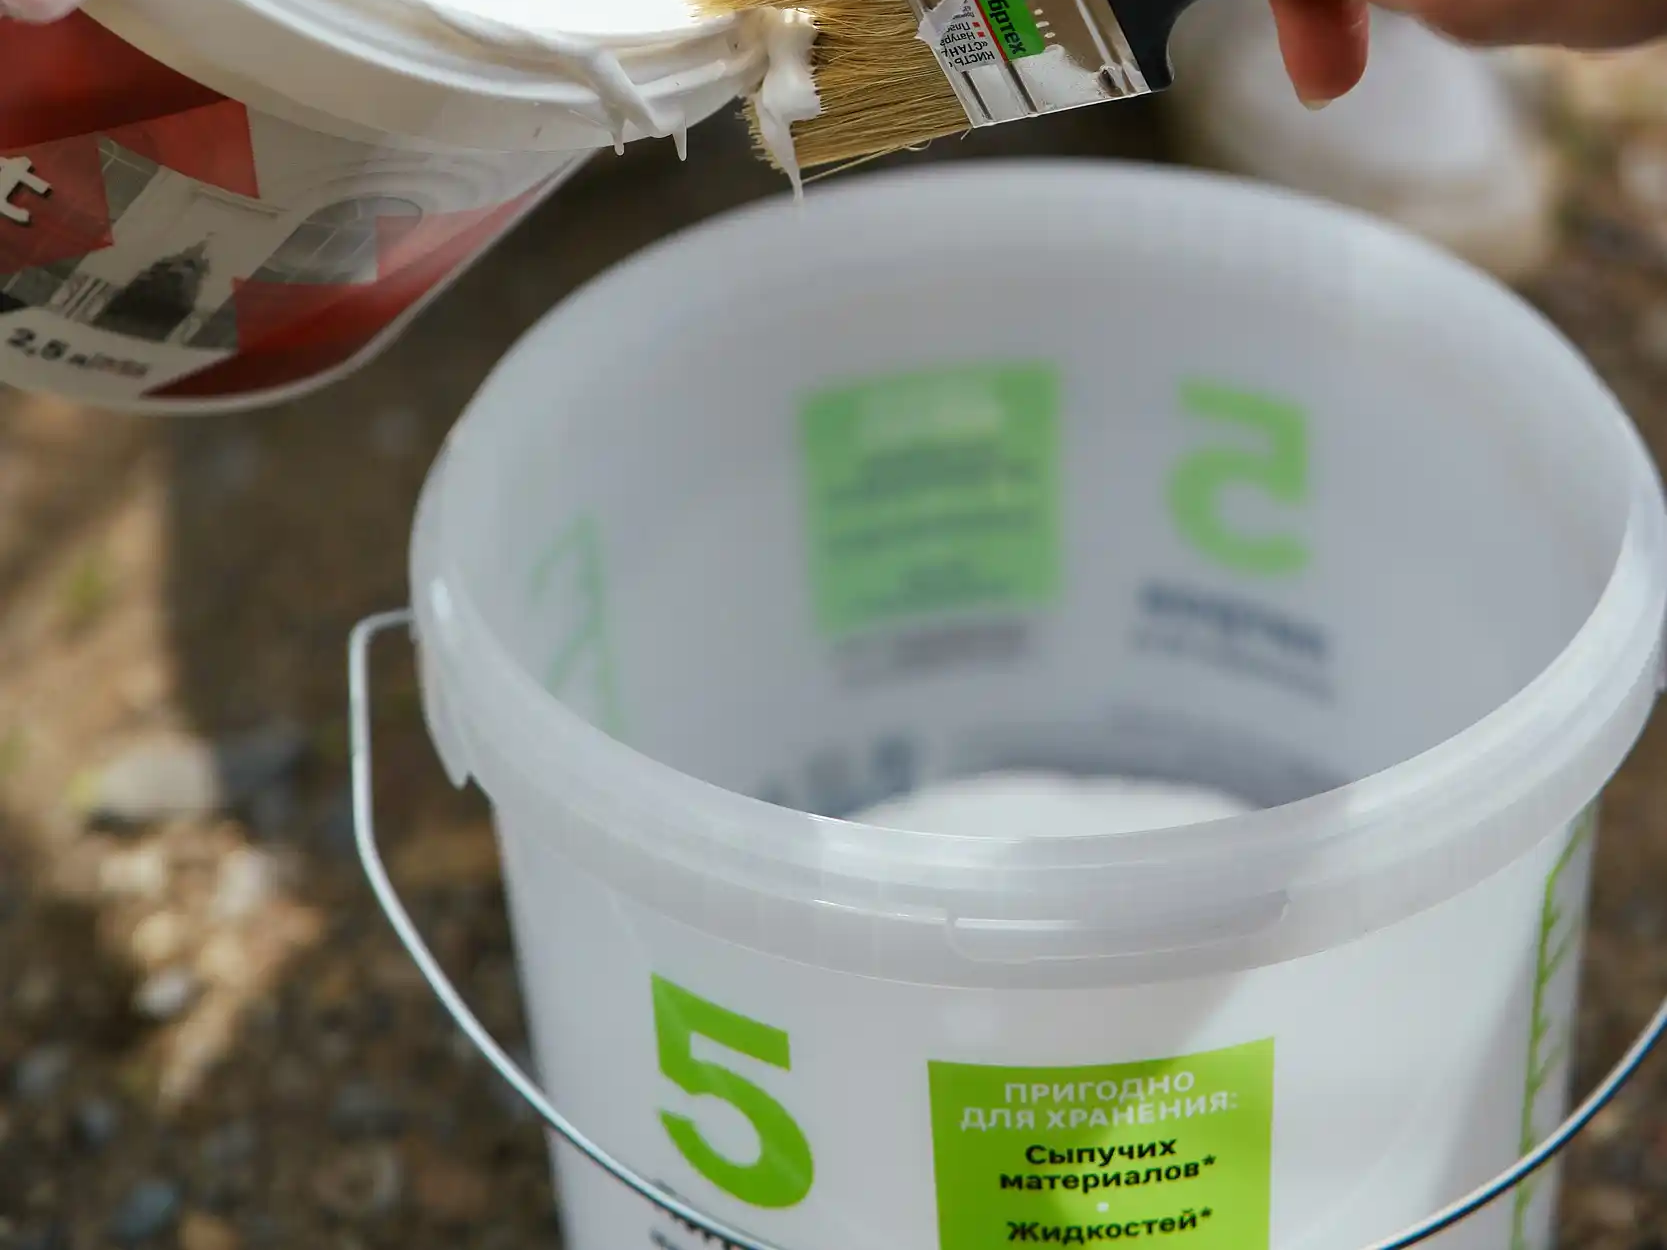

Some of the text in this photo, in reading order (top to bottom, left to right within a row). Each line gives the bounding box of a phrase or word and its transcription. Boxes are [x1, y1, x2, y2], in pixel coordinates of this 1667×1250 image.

[955, 50, 996, 67] КИСТЬ
[650, 970, 815, 1211] 5
[1004, 1071, 1195, 1104] ПРИГОДНО
[960, 1091, 1239, 1132] ДЛЯ ХРАНЕНИЯ:
[1025, 1137, 1178, 1167] Сыпучих
